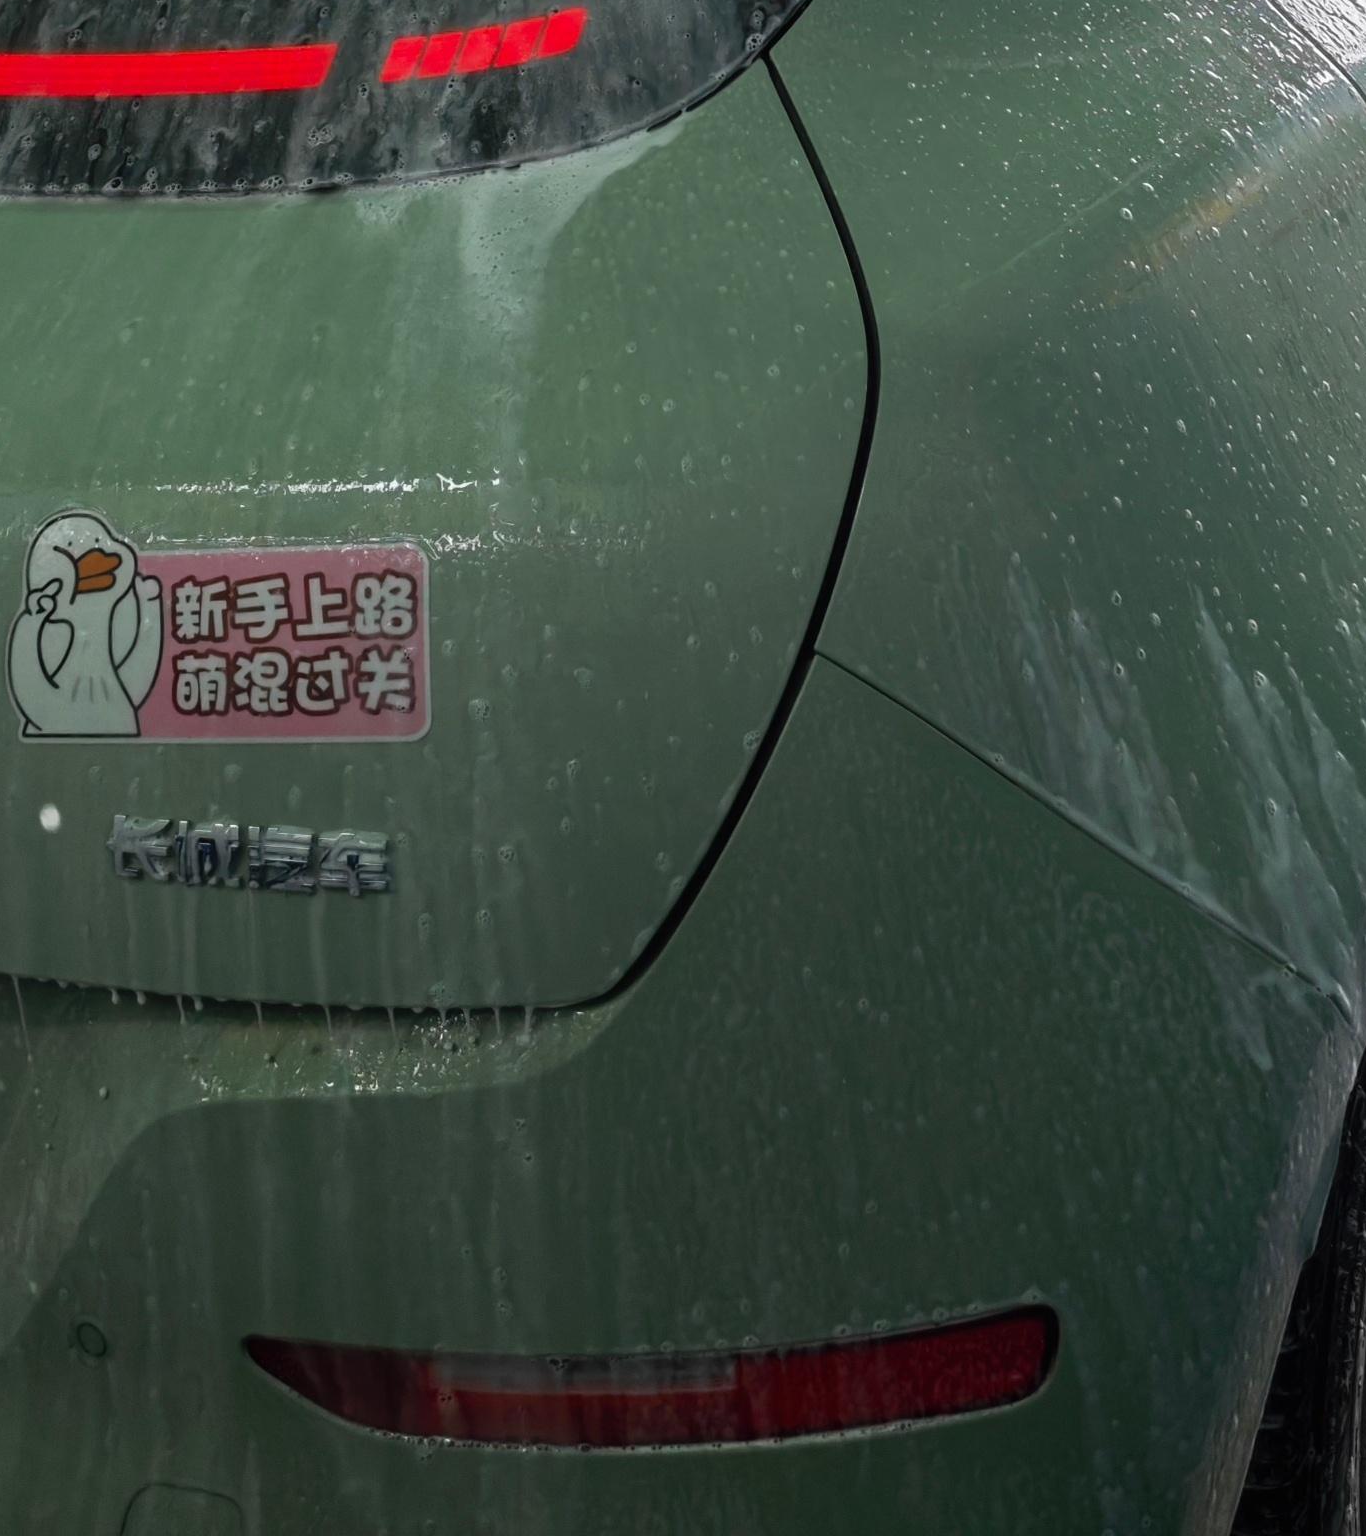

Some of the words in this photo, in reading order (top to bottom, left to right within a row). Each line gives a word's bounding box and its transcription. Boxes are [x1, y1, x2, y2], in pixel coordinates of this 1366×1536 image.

[172, 568, 419, 644] 新手上路
[172, 646, 417, 718] 萌混过关
[106, 814, 390, 897] 长城汽车
